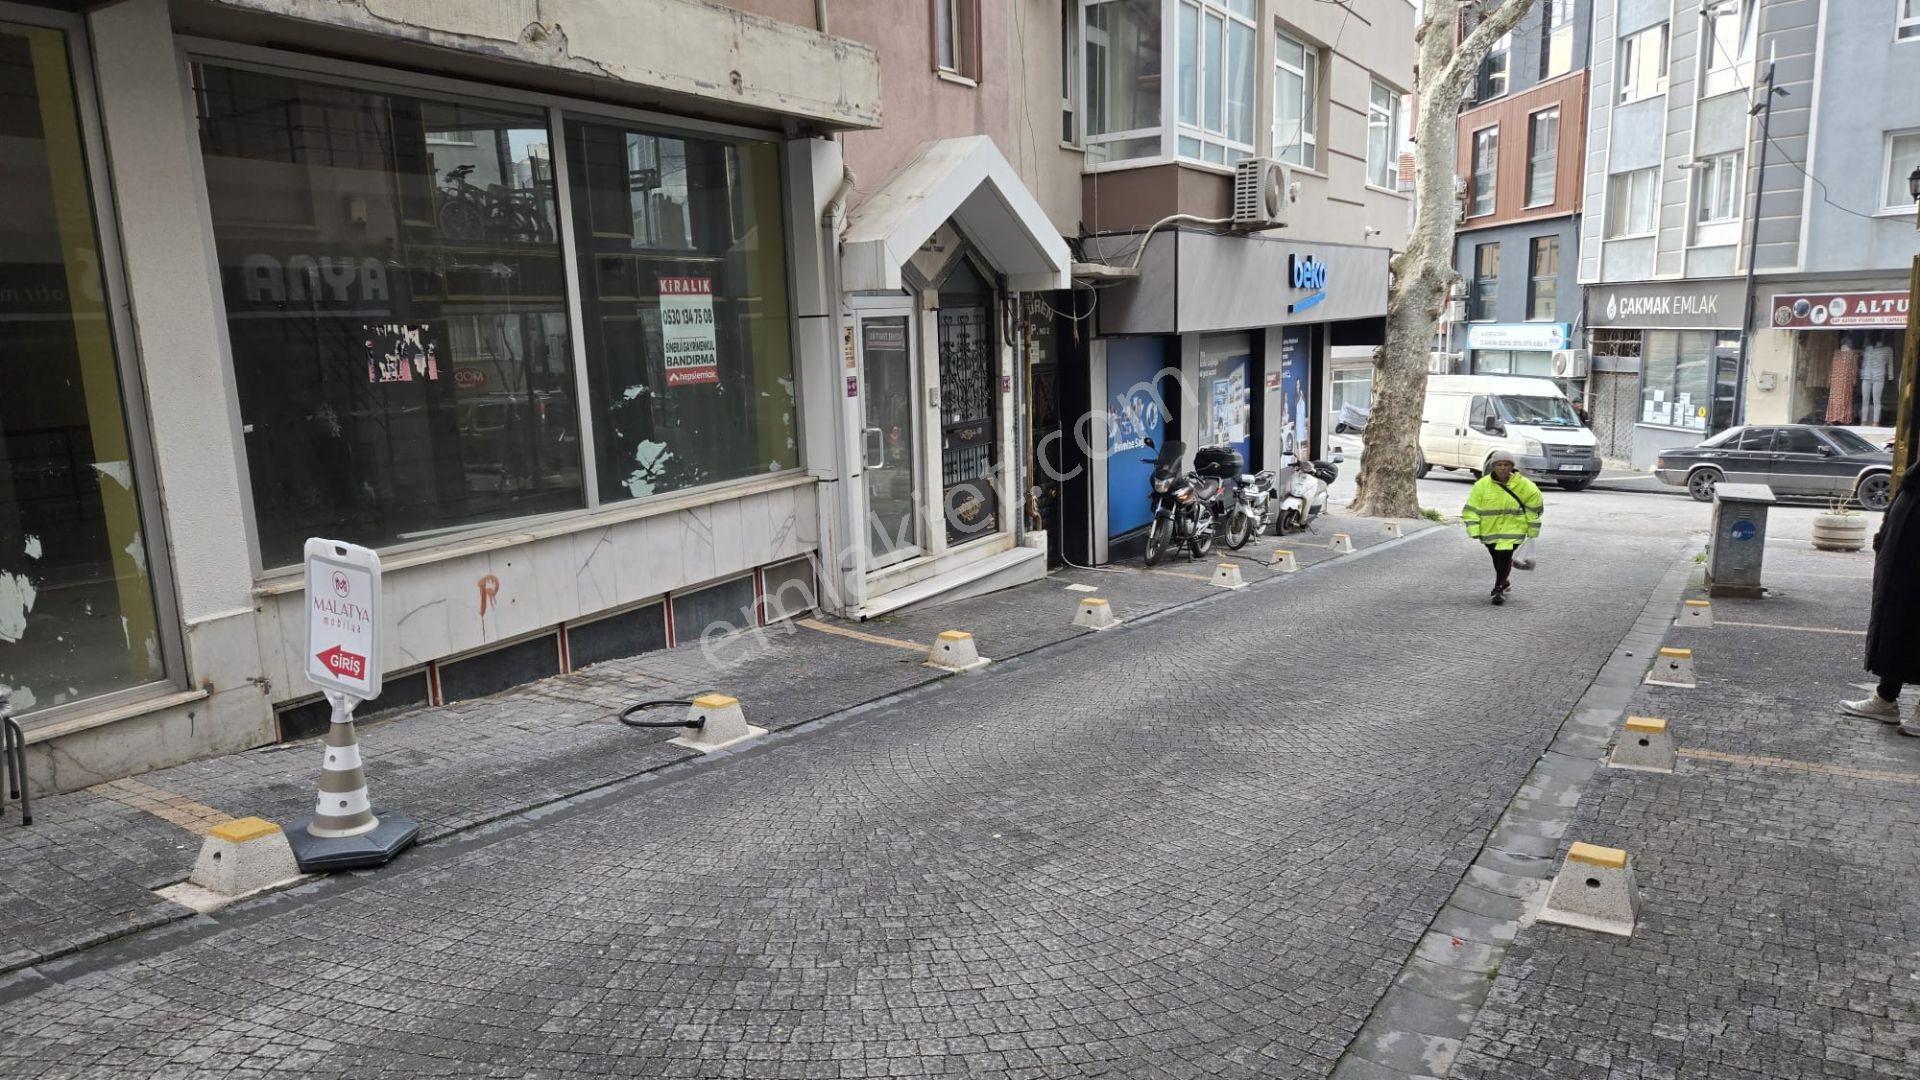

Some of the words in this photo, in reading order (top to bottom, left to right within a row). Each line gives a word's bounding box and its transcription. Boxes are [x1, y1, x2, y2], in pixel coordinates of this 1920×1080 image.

[1289, 254, 1327, 288] beko
[660, 279, 710, 293] KİRALIK
[1620, 296, 1671, 318] ÇAKMAK
[1673, 294, 1718, 315] EMLAK
[666, 354, 715, 367] BANDIRMA
[314, 597, 370, 622] MALATYA
[330, 653, 361, 676] GİRİŞ
